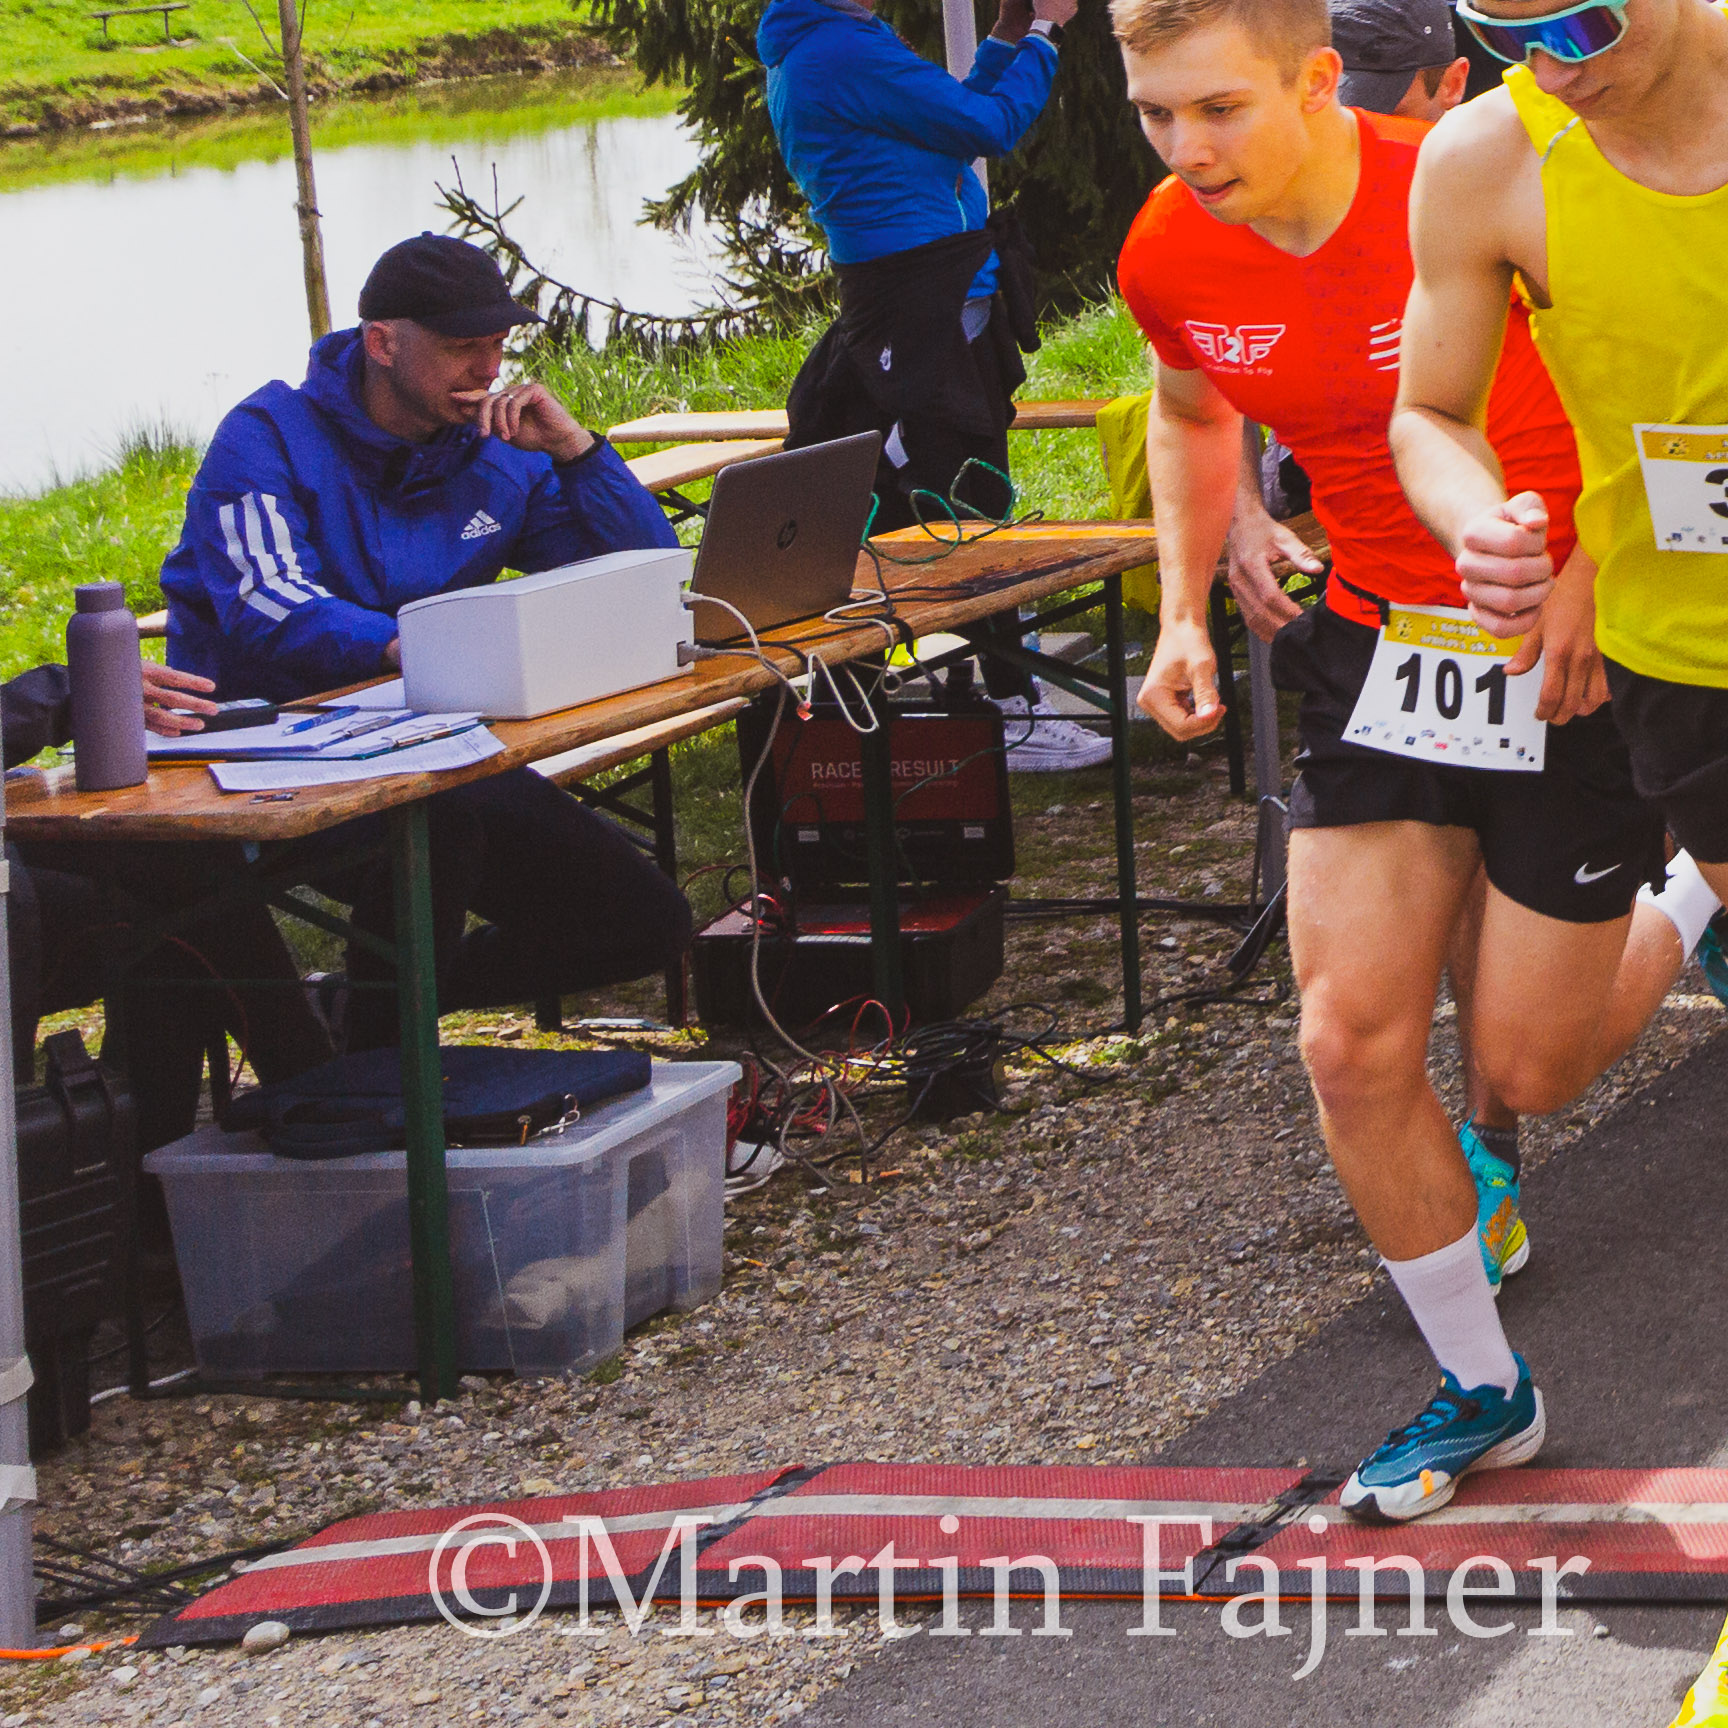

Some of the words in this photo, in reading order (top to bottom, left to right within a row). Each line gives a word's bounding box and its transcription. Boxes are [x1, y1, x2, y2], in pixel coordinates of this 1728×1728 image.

[460, 523, 502, 540] adidas
[1395, 653, 1507, 726] 101
[811, 762, 862, 780] RACE
